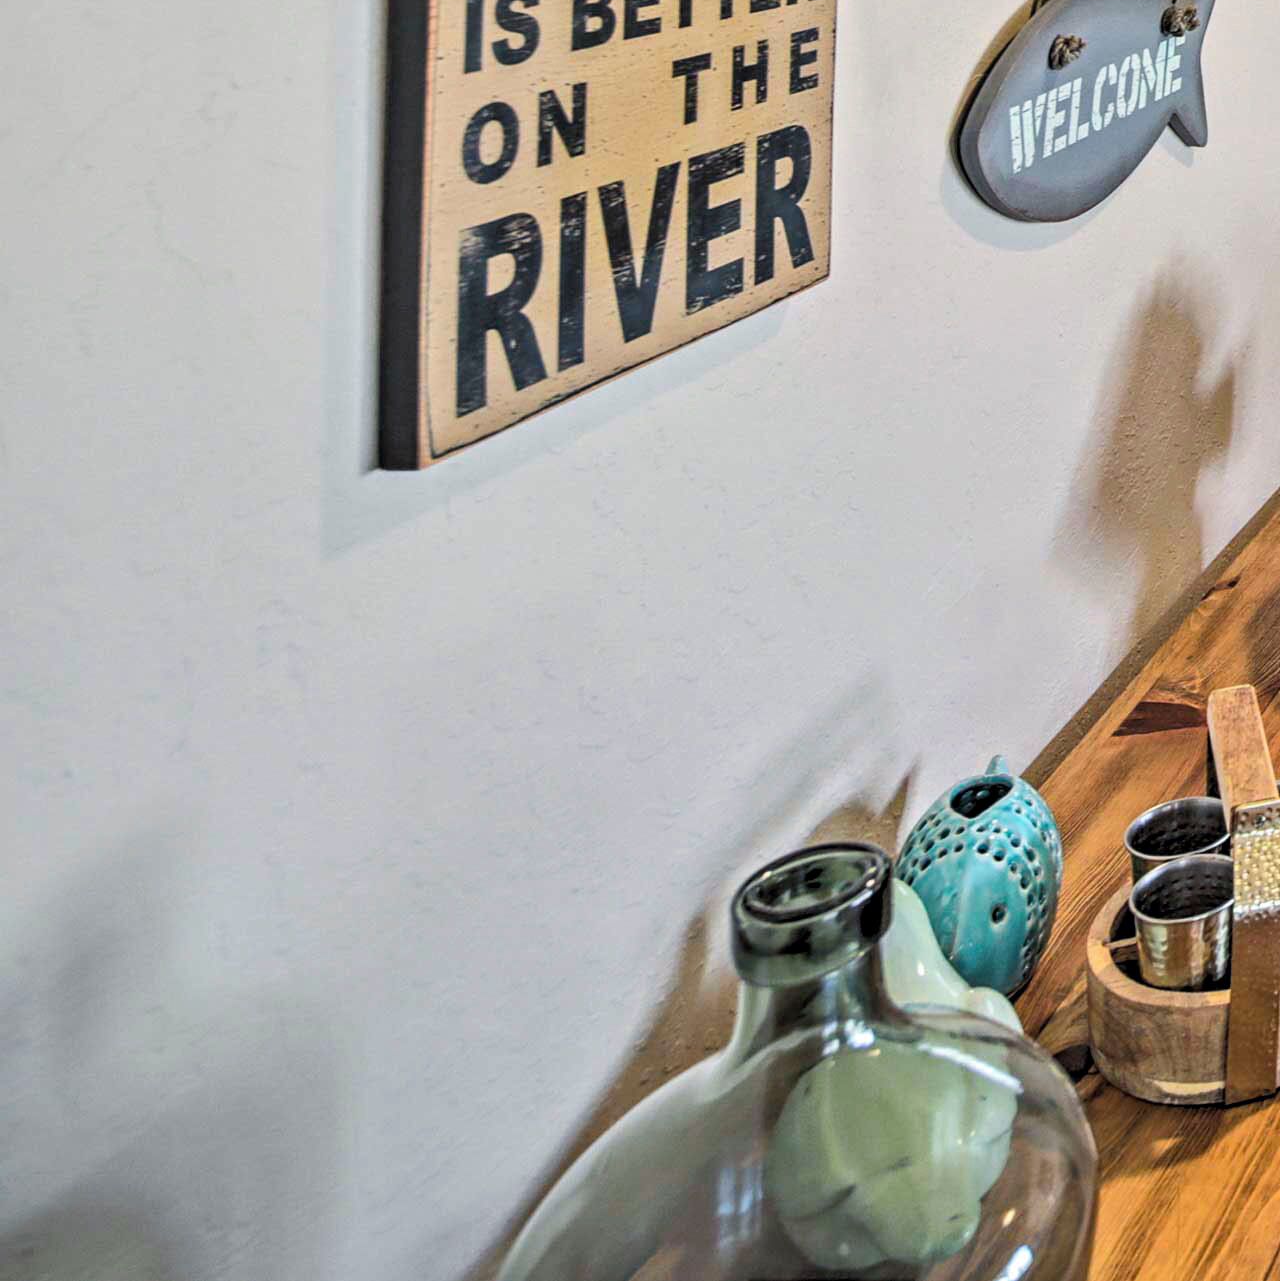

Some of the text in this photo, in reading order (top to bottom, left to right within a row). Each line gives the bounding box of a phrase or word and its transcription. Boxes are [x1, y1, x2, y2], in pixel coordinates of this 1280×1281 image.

[462, 27, 820, 185] ON THE
[1009, 35, 1187, 174] WELCOME
[455, 124, 816, 418] RIVER
